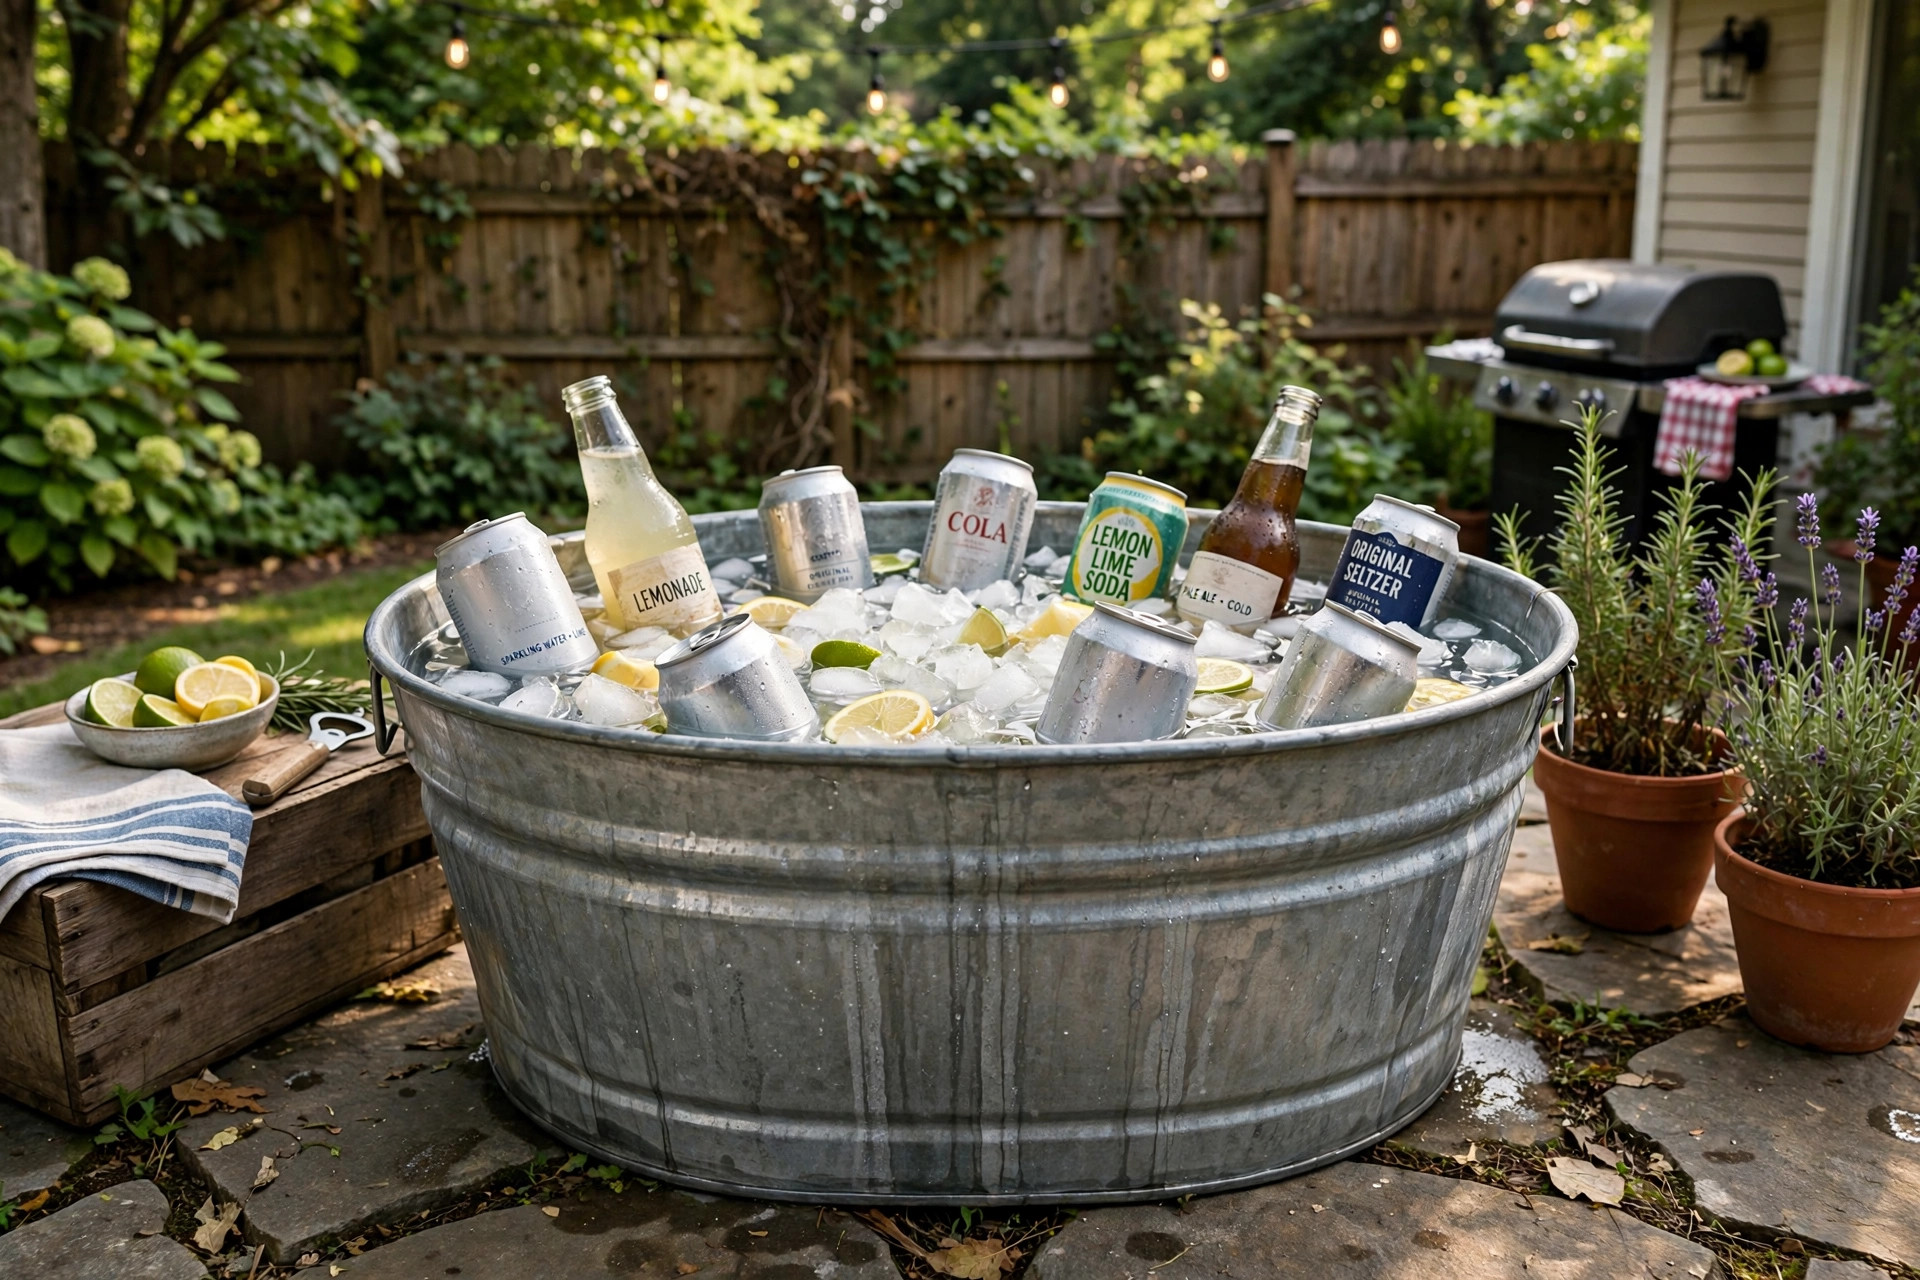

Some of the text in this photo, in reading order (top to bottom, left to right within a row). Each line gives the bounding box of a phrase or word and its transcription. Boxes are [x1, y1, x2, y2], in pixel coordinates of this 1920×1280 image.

[947, 511, 1007, 544] COLA
[1091, 524, 1153, 559] LEMON
[1090, 547, 1137, 578] LIME
[1350, 538, 1413, 579] ORIGINAL
[632, 572, 706, 613] LEMONADE
[1082, 570, 1130, 602] SODA
[1343, 562, 1403, 600] SELTZER
[1227, 599, 1252, 616] COLD
[500, 643, 542, 666] SPARKLING
[542, 633, 567, 649] WATER
